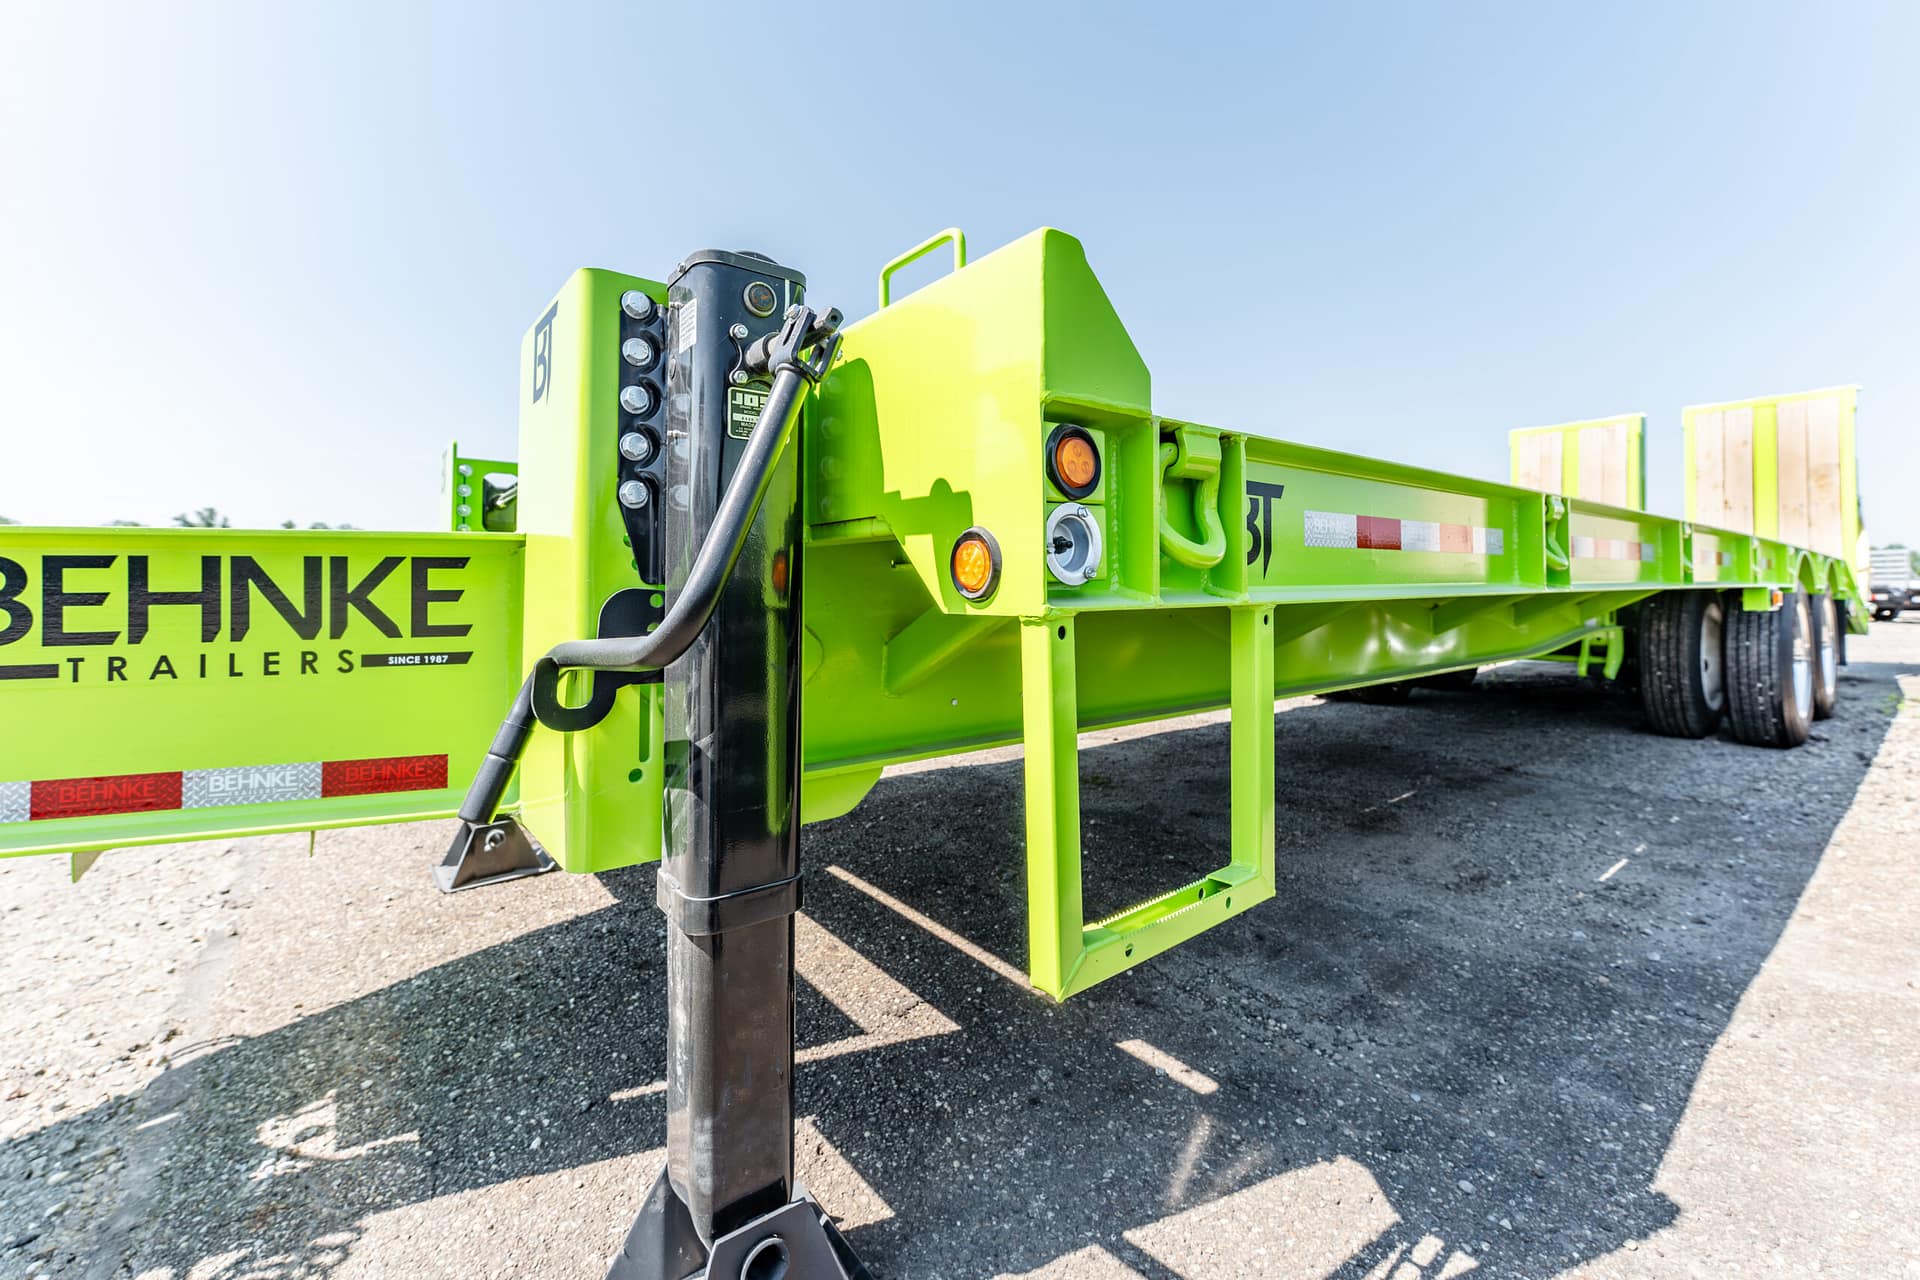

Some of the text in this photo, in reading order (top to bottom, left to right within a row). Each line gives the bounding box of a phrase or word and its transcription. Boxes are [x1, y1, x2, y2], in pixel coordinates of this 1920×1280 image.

[67, 649, 354, 683] TRAILERS
[388, 655, 448, 665] SINCE 1987
[209, 770, 298, 792] BEHNKE
[345, 761, 426, 782] BEHNKE
[59, 781, 156, 803] BEHNKE
